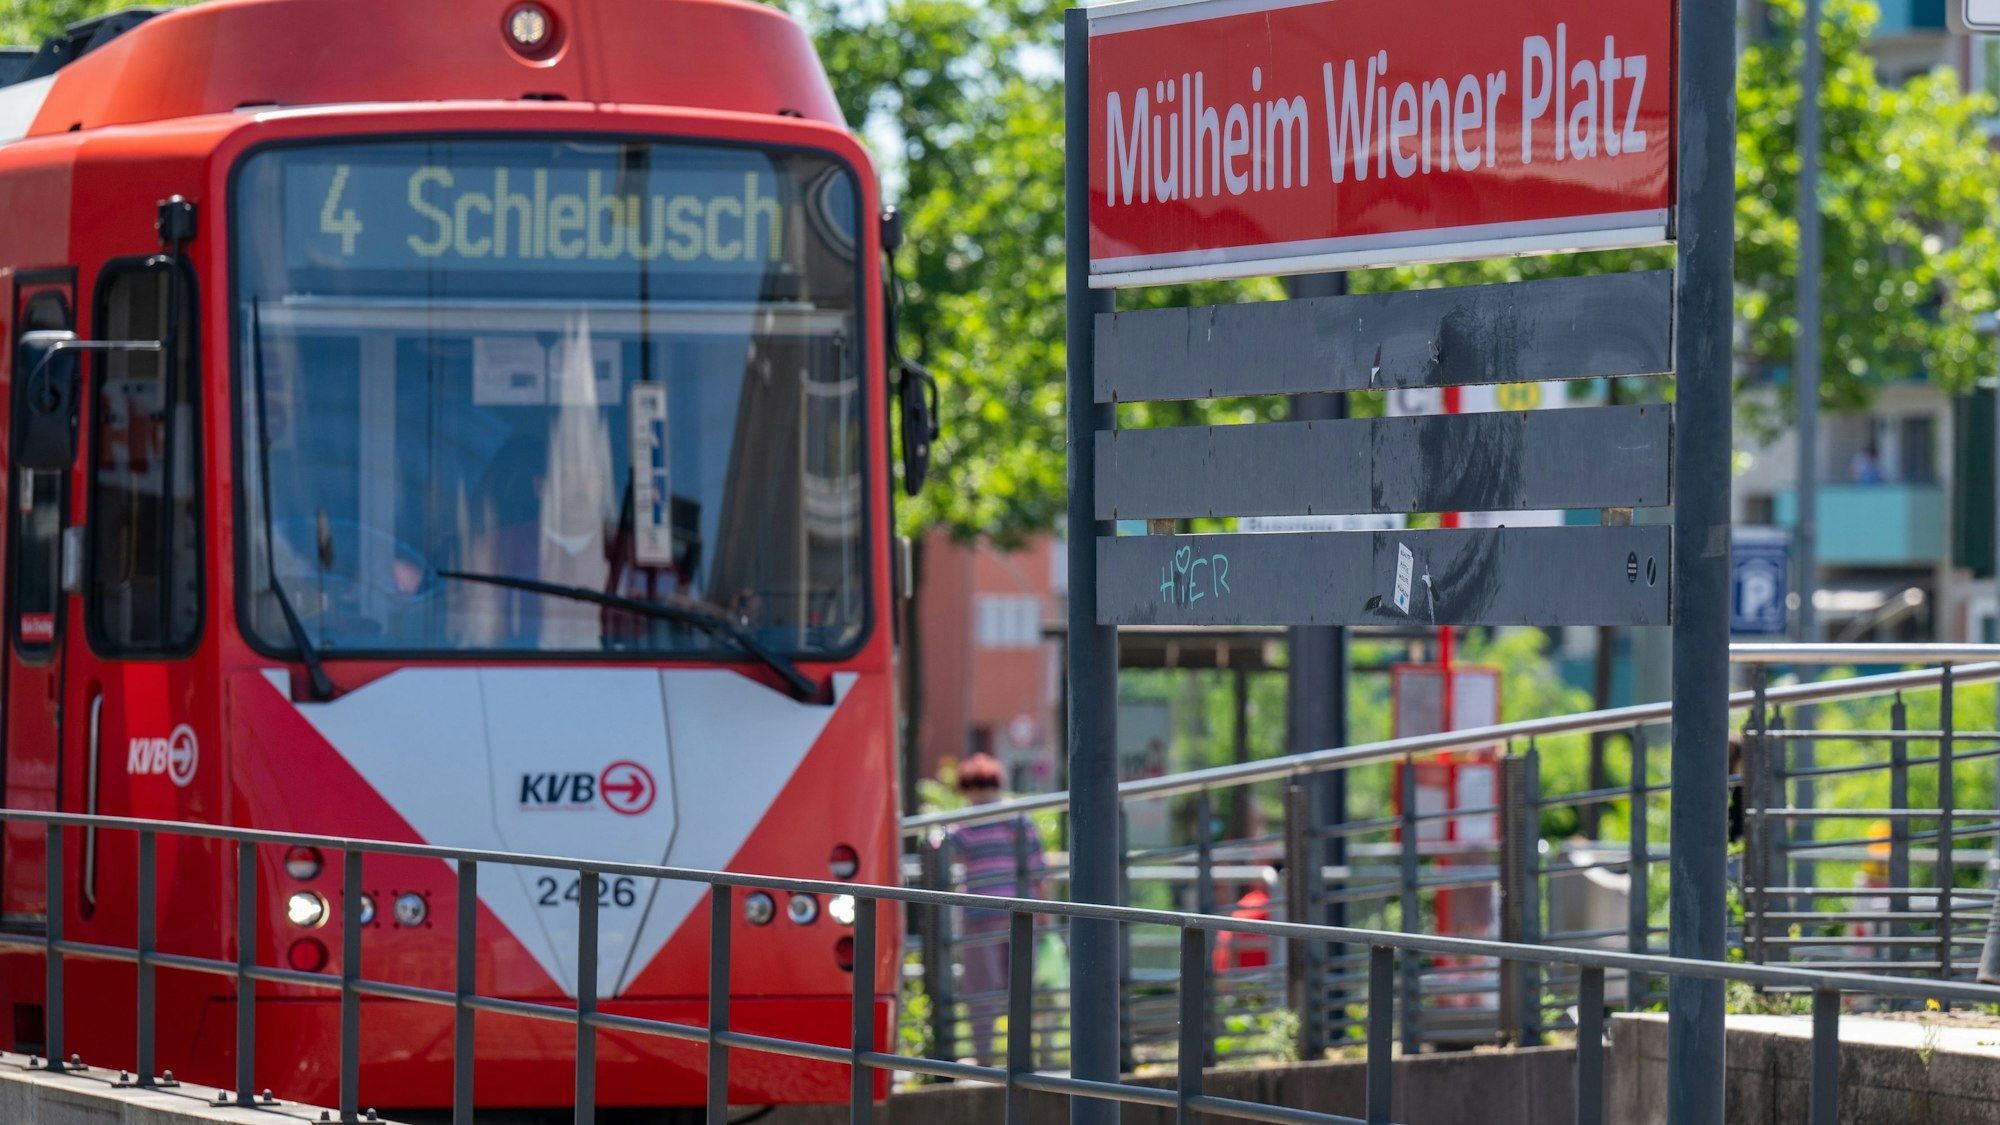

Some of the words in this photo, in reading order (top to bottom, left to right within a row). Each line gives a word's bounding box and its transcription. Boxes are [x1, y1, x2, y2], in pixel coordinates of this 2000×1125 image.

[1106, 67, 1309, 207] Mülheim
[1323, 50, 1506, 184] Wiener
[1521, 22, 1648, 164] Platz
[320, 165, 363, 256] 4
[407, 166, 782, 261] Schlebusch
[1742, 577, 1775, 621] P
[127, 737, 169, 775] KVB
[520, 773, 596, 804] KVB
